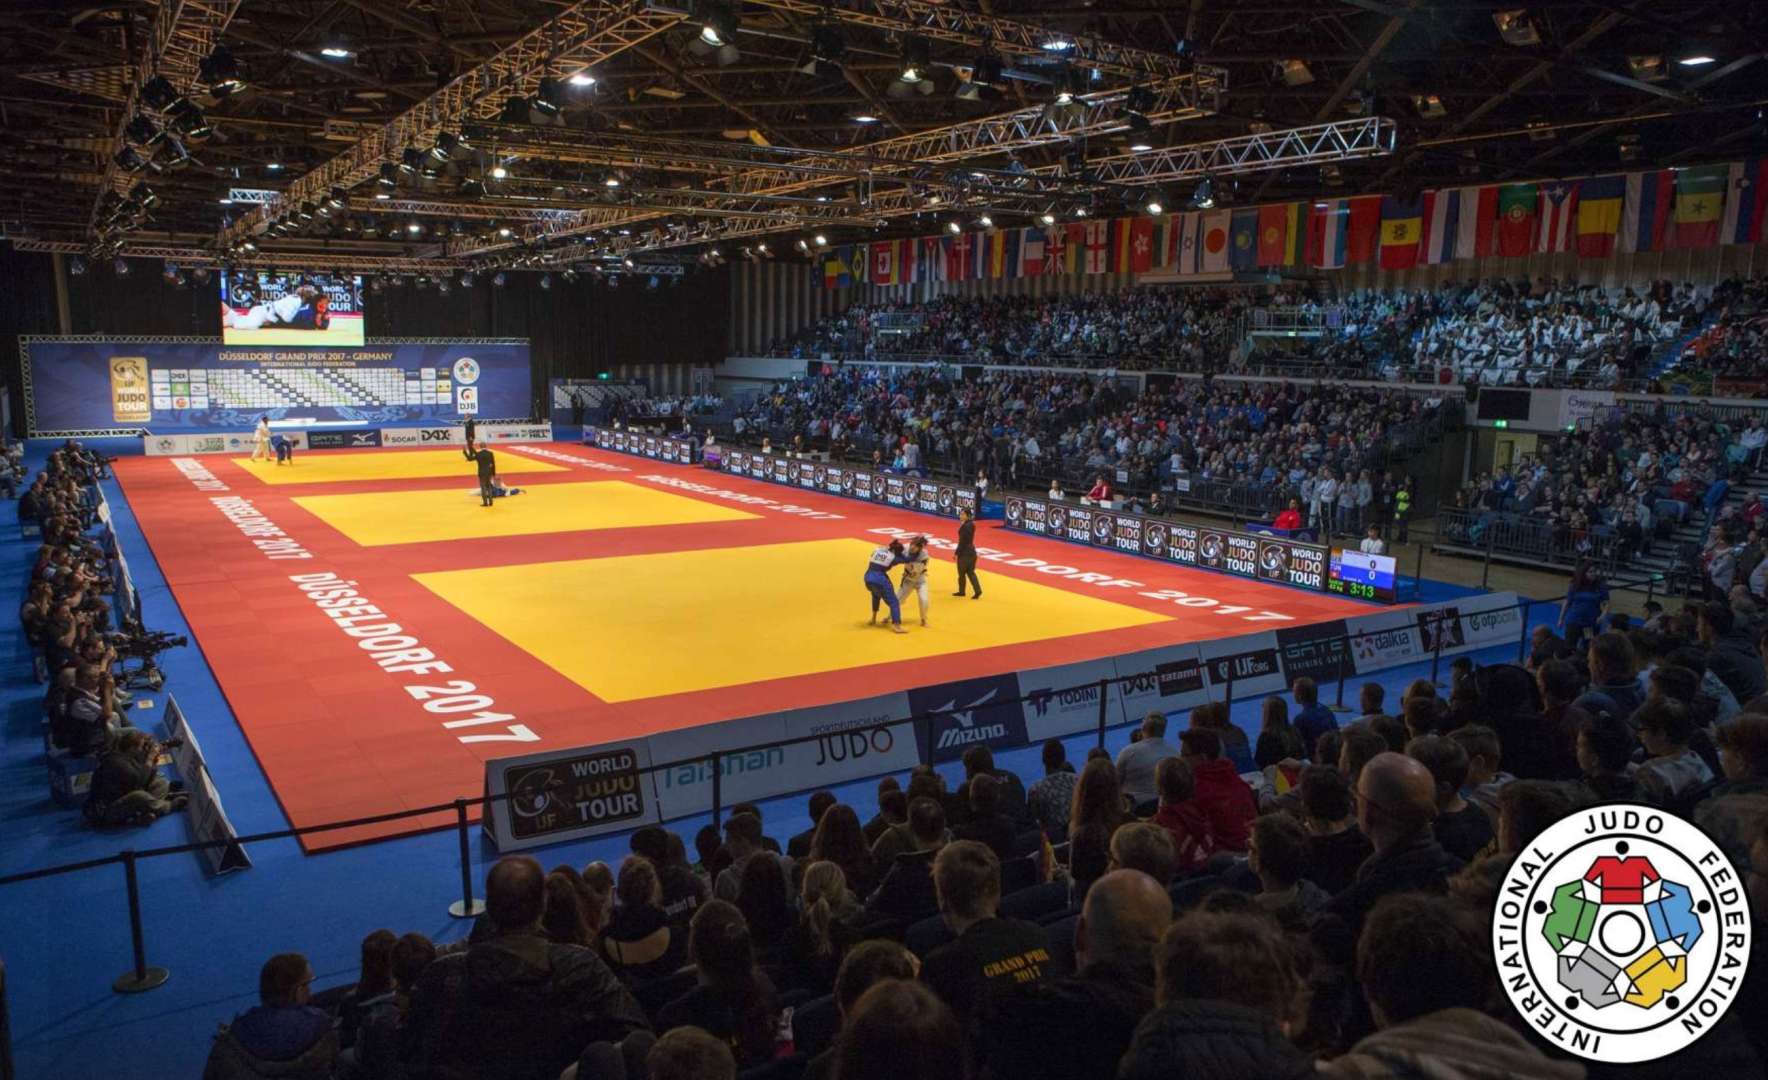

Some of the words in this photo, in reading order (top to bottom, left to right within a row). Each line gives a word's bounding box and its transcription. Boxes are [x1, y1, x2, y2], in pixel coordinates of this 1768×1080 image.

[329, 293, 350, 302] UDO
[328, 303, 350, 311] OUR
[219, 351, 273, 361] DÜSSELDORF
[275, 352, 306, 361] GRAND
[308, 352, 326, 361] PRIX
[328, 352, 344, 361] 2017
[353, 352, 392, 361] GERMANY
[118, 394, 146, 402] JUDO
[118, 403, 146, 411] TOUR
[460, 402, 476, 410] DJB
[856, 488, 870, 498] TOUR
[888, 494, 903, 504] TOUR
[920, 500, 937, 511] TOUR
[1026, 502, 1046, 512] WORLD
[1025, 511, 1045, 522] JUDO
[1068, 509, 1091, 520] WORLD
[1024, 520, 1045, 531] TOUR
[1068, 518, 1090, 530] JUDO
[1116, 517, 1141, 528] WORLD
[1068, 528, 1090, 540] TOUR
[1116, 526, 1140, 540] JUDO
[1170, 527, 1196, 538] WORLD
[1116, 536, 1140, 550] TOUR
[1170, 536, 1196, 550] JUDO
[1228, 536, 1256, 548] WORLD
[252, 537, 314, 560] 2017
[1168, 547, 1196, 562] TOUR
[1226, 546, 1256, 561] JUDO
[1291, 548, 1322, 561] WORLD
[1226, 557, 1255, 574] TOUR
[1290, 558, 1322, 574] JUDO
[1370, 560, 1376, 570] 0
[1289, 570, 1321, 587] TOUR
[1368, 570, 1376, 580] 0
[1350, 582, 1374, 598] 3:13
[1139, 588, 1296, 622] 2017
[288, 572, 454, 674] DÜSSELDORF
[403, 680, 542, 744] 2017
[1058, 687, 1098, 707] TODINI
[816, 728, 894, 766] JUDO
[572, 754, 632, 778] WORLD
[576, 793, 640, 823] TOUR
[983, 956, 1025, 977] GRAND
[1014, 964, 1042, 983] 2017
